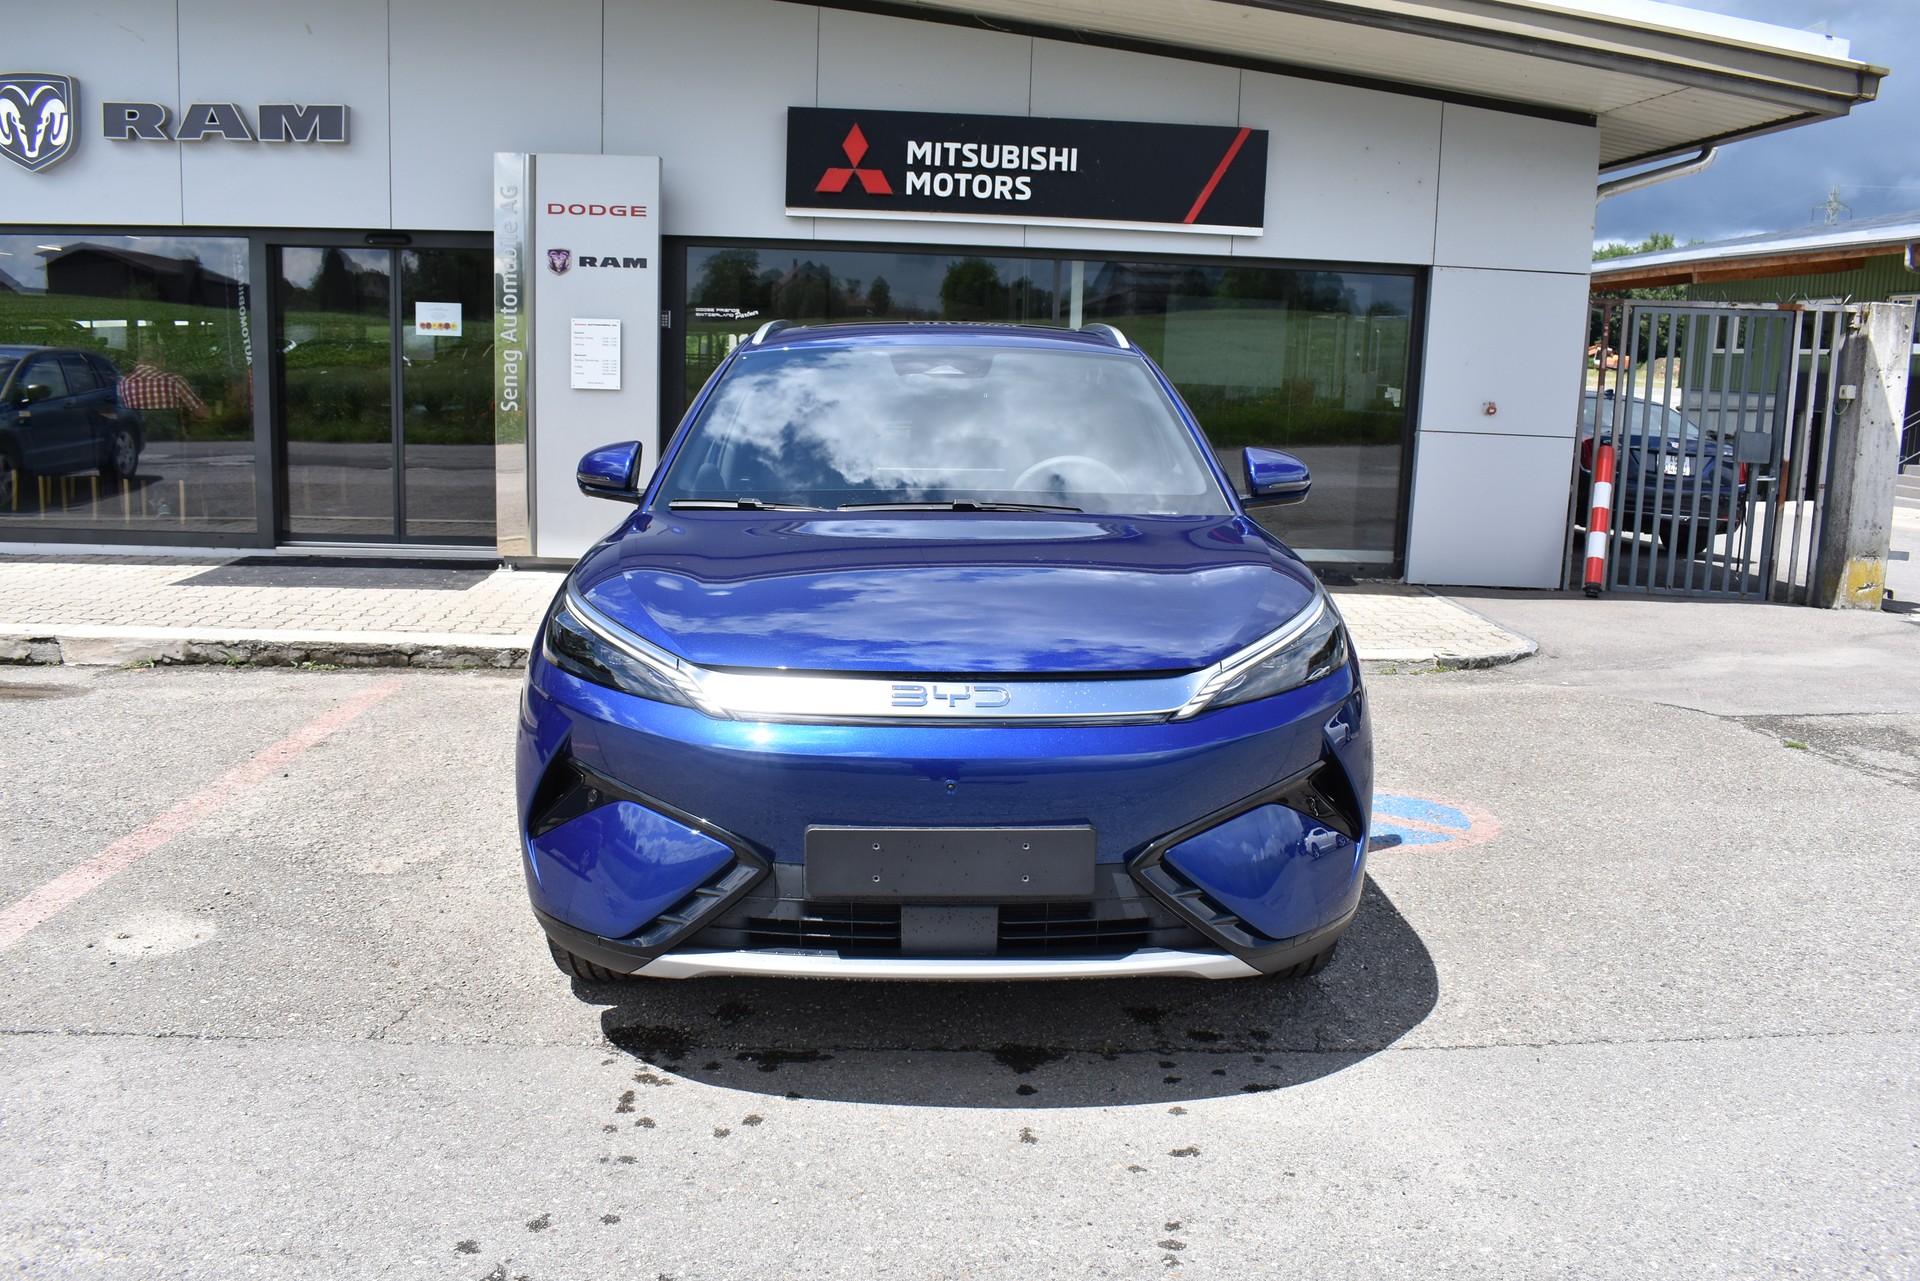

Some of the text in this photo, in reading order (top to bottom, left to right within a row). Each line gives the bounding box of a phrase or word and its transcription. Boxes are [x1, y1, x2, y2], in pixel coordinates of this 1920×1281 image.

[102, 102, 348, 142] RAM
[906, 140, 1078, 172] MITSUBISHI
[905, 171, 1032, 201] MOTORS
[547, 203, 647, 217] DODGE
[578, 256, 648, 269] RAM
[500, 185, 523, 412] Senag Automobile AG
[891, 685, 1011, 708] BYD
